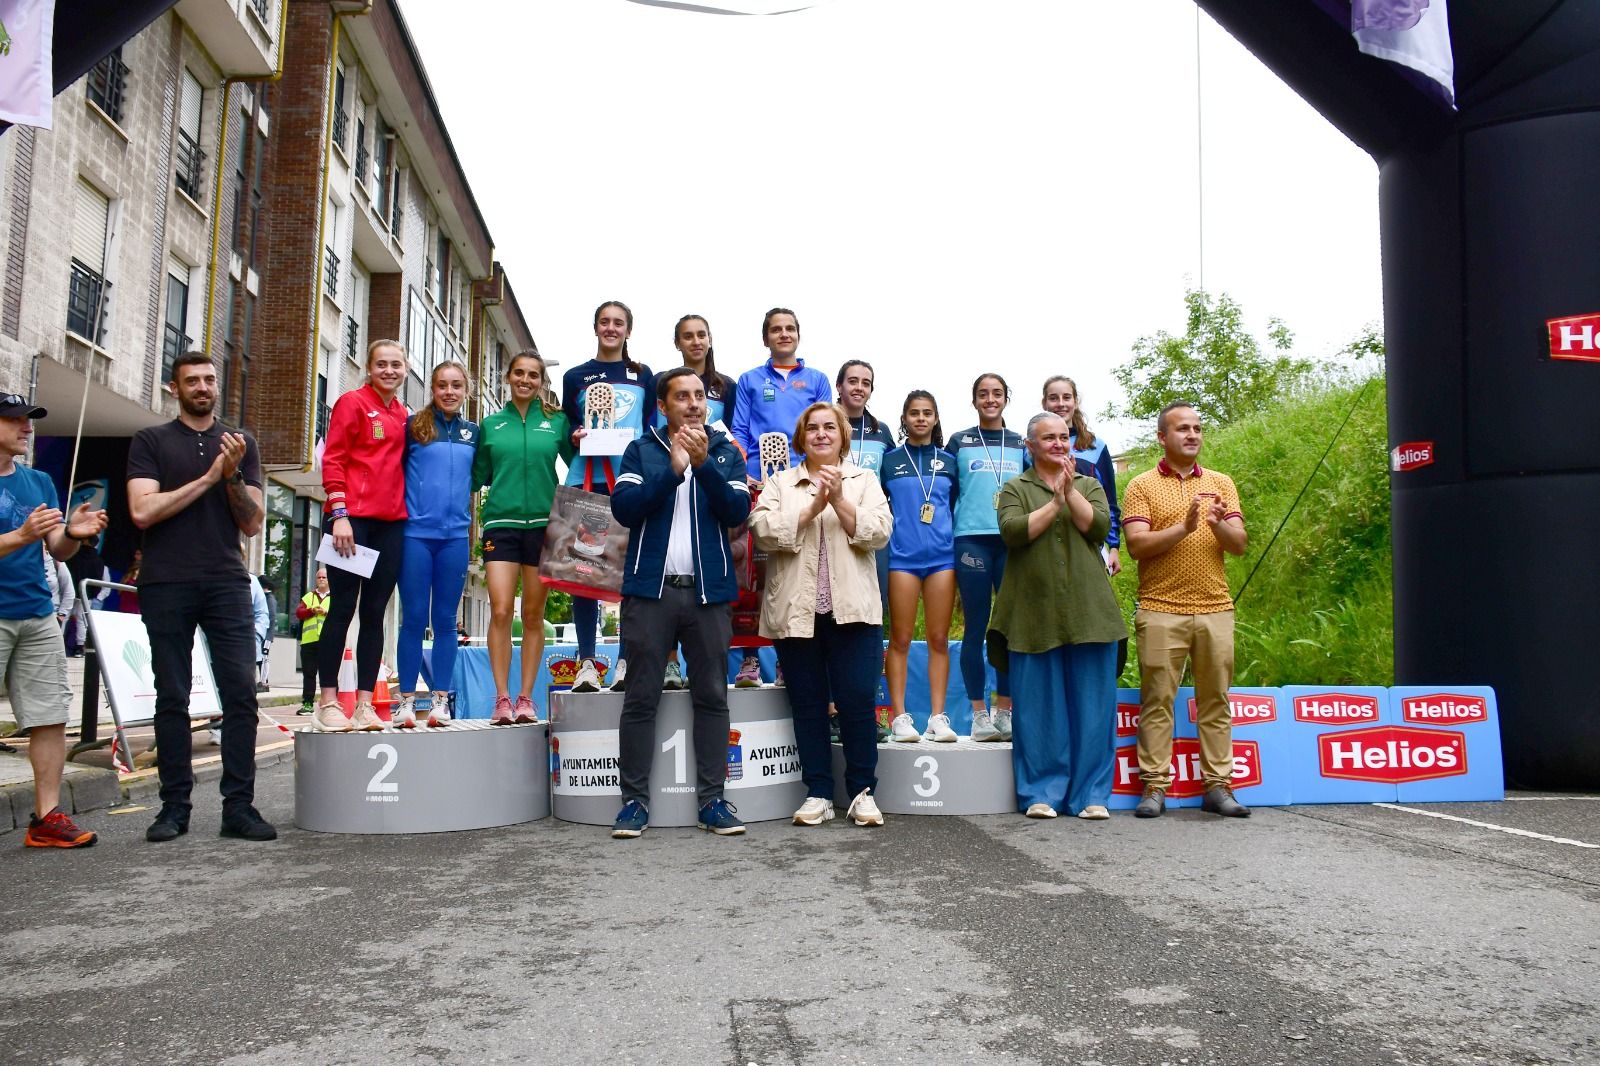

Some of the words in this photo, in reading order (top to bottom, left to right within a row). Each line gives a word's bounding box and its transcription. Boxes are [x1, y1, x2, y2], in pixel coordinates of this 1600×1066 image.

[1559, 325, 1600, 350] H
[1300, 701, 1374, 718] Helios
[1409, 701, 1482, 718] Helios
[662, 729, 686, 784] 1
[1330, 740, 1457, 769] Helios
[366, 743, 398, 792] 2
[762, 764, 776, 777] DE
[913, 755, 940, 797] 3
[569, 775, 579, 787] DE
[581, 774, 621, 787] LLANER
